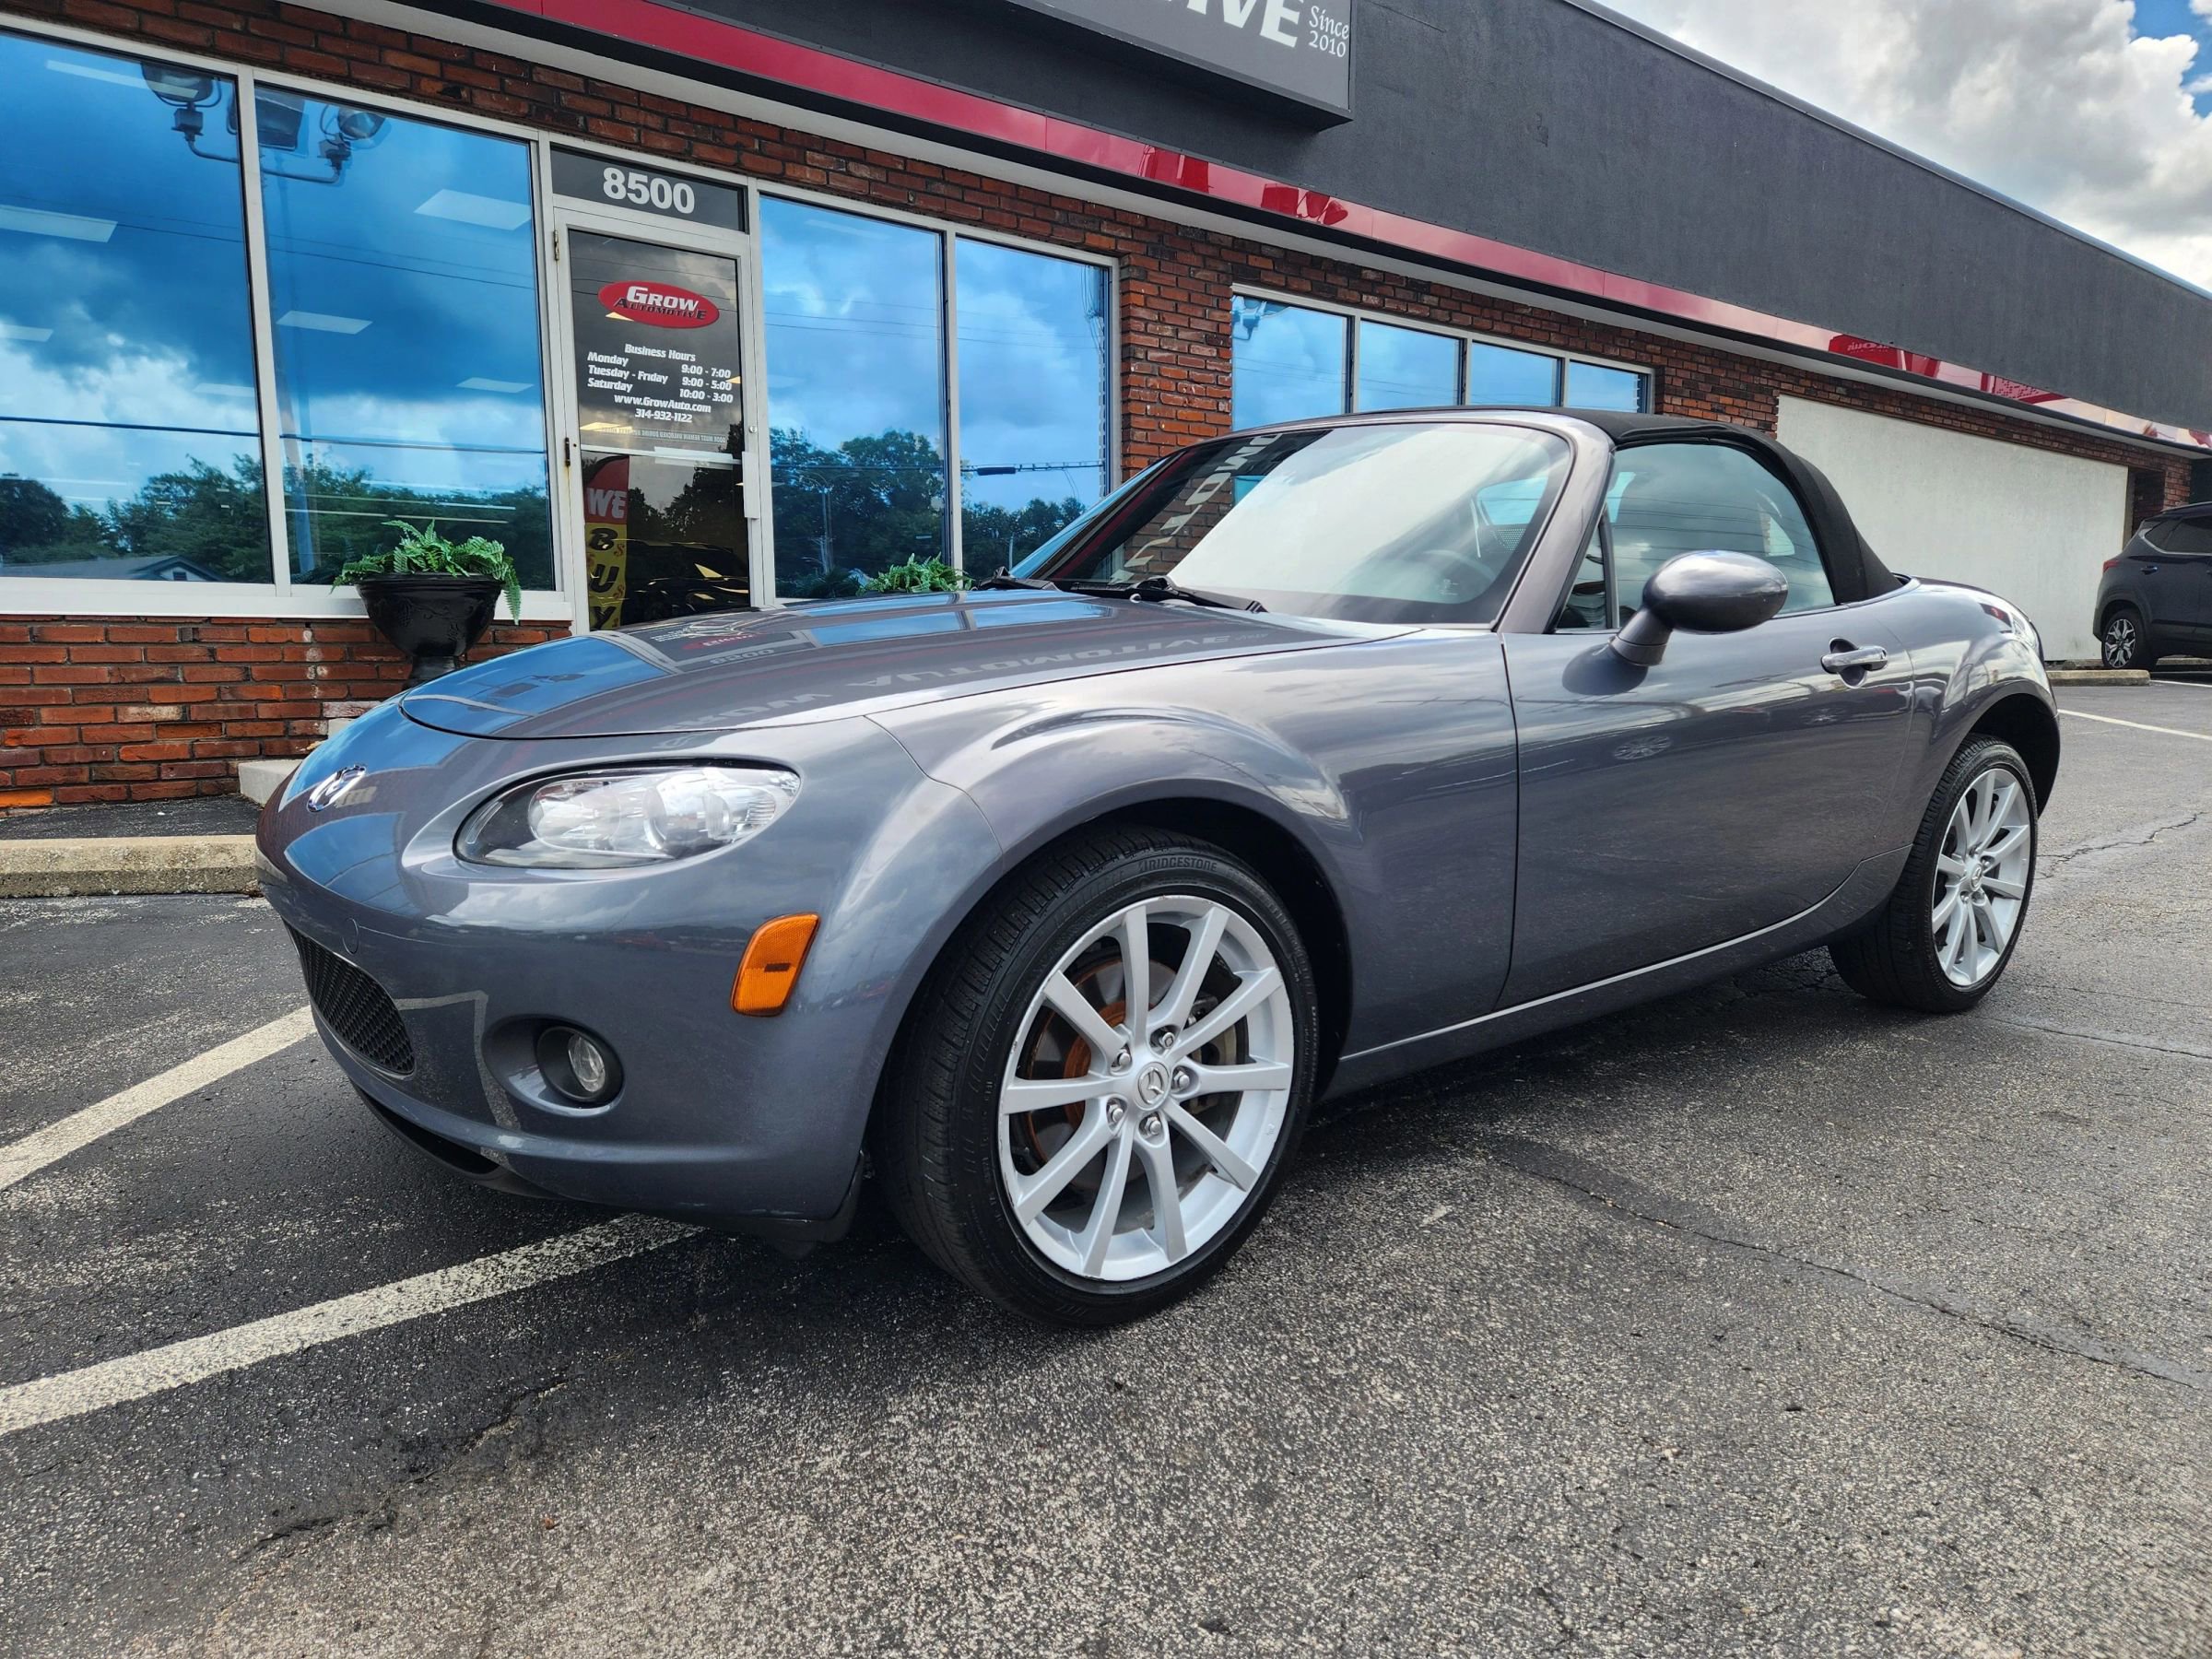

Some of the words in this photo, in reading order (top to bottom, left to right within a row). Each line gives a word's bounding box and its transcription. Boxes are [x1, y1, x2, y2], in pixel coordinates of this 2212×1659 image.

[1309, 6, 1349, 40] Since
[1308, 29, 1347, 58] 2010
[603, 167, 695, 214] 8500
[587, 351, 629, 367] Monday
[681, 363, 703, 375] 9:00
[711, 368, 731, 379] 7:00
[624, 343, 666, 359] Business
[667, 349, 697, 362] Hours
[587, 377, 633, 393] Saturday
[679, 388, 705, 400] 10:00
[712, 393, 734, 403] 3:00
[588, 364, 629, 380] Tuesday
[637, 371, 668, 384] Friday
[682, 376, 704, 388] 9:00
[711, 381, 732, 391] 5:00
[614, 394, 712, 413] www.GrowAuto.com
[634, 407, 693, 423] 314-932-1122
[587, 488, 627, 519] WE
[588, 527, 620, 630] BUY
